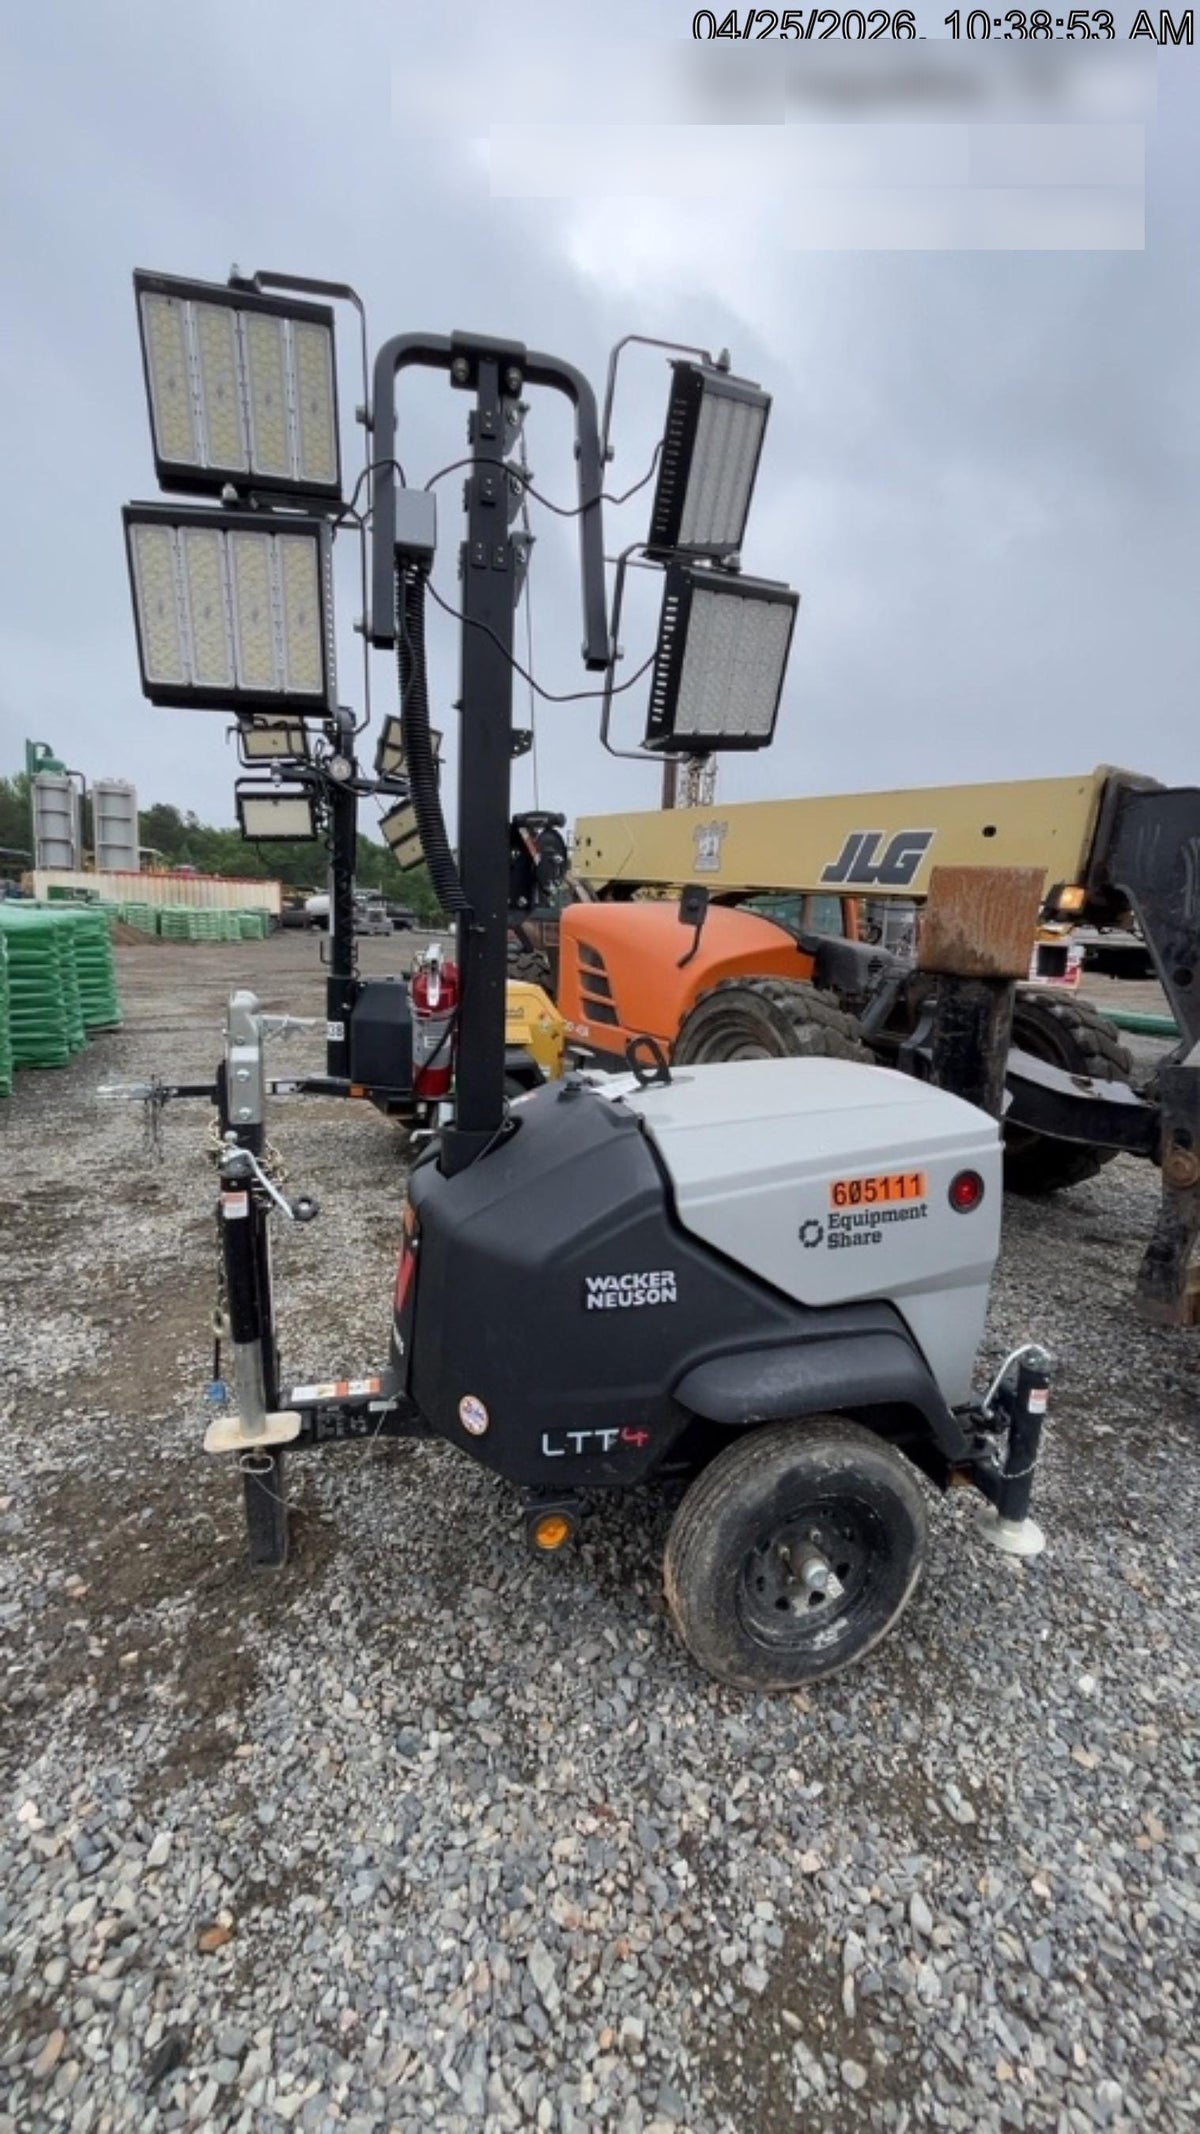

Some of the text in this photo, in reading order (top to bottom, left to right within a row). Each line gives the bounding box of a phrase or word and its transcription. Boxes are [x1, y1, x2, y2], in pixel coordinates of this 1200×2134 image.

[819, 829, 936, 888] JLG
[833, 1173, 923, 1206] 605111
[827, 1203, 928, 1231] Equipment
[827, 1230, 883, 1250] Share
[585, 1270, 676, 1293] WACKER
[587, 1287, 677, 1309] NEUSON
[542, 1427, 648, 1456] LTT4
